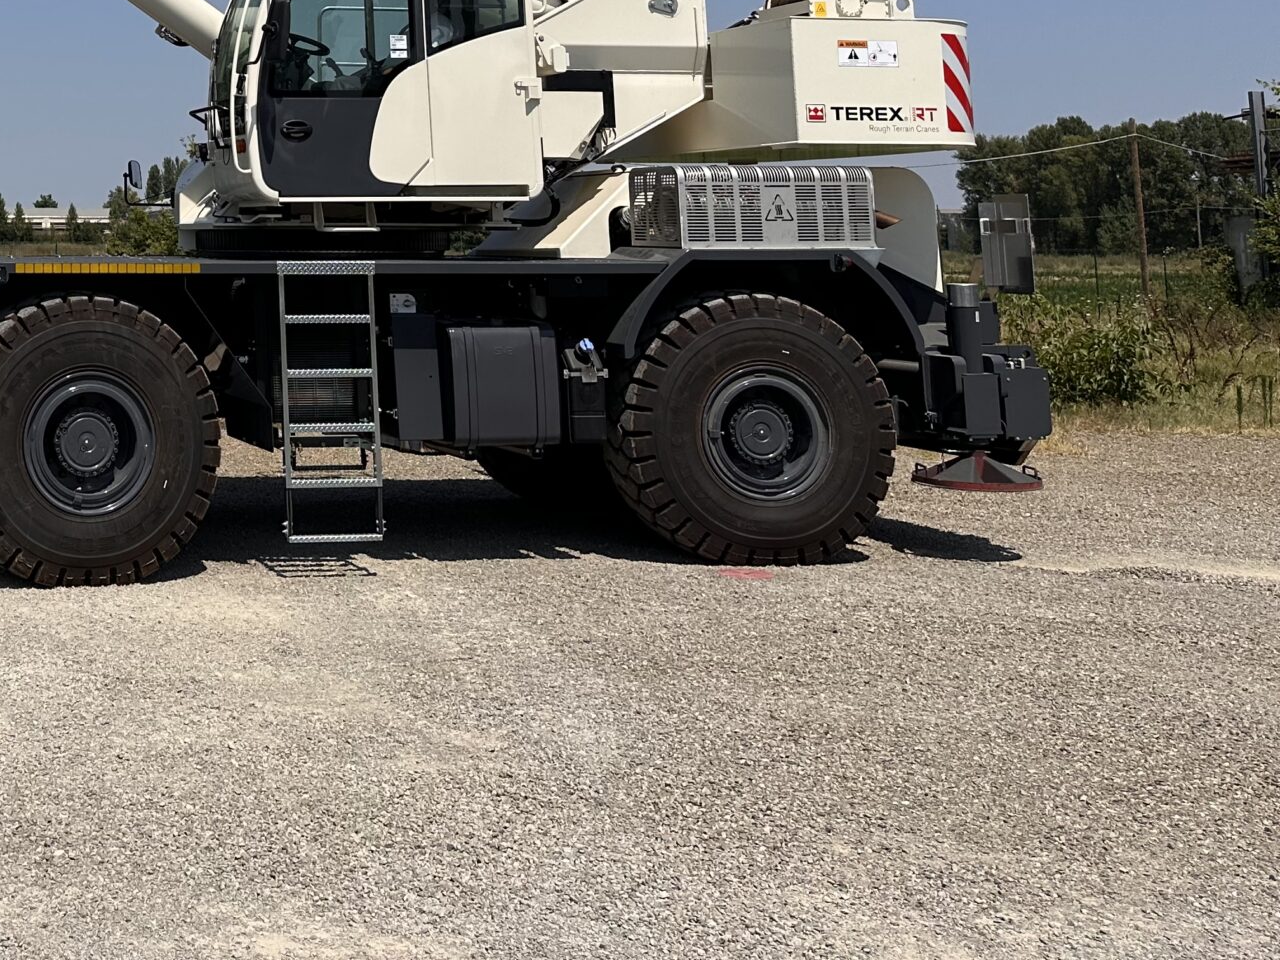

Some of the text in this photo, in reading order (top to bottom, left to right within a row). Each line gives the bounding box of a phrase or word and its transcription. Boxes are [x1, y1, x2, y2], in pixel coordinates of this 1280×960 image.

[830, 107, 937, 121] TEREX RT
[869, 125, 891, 133] Rough
